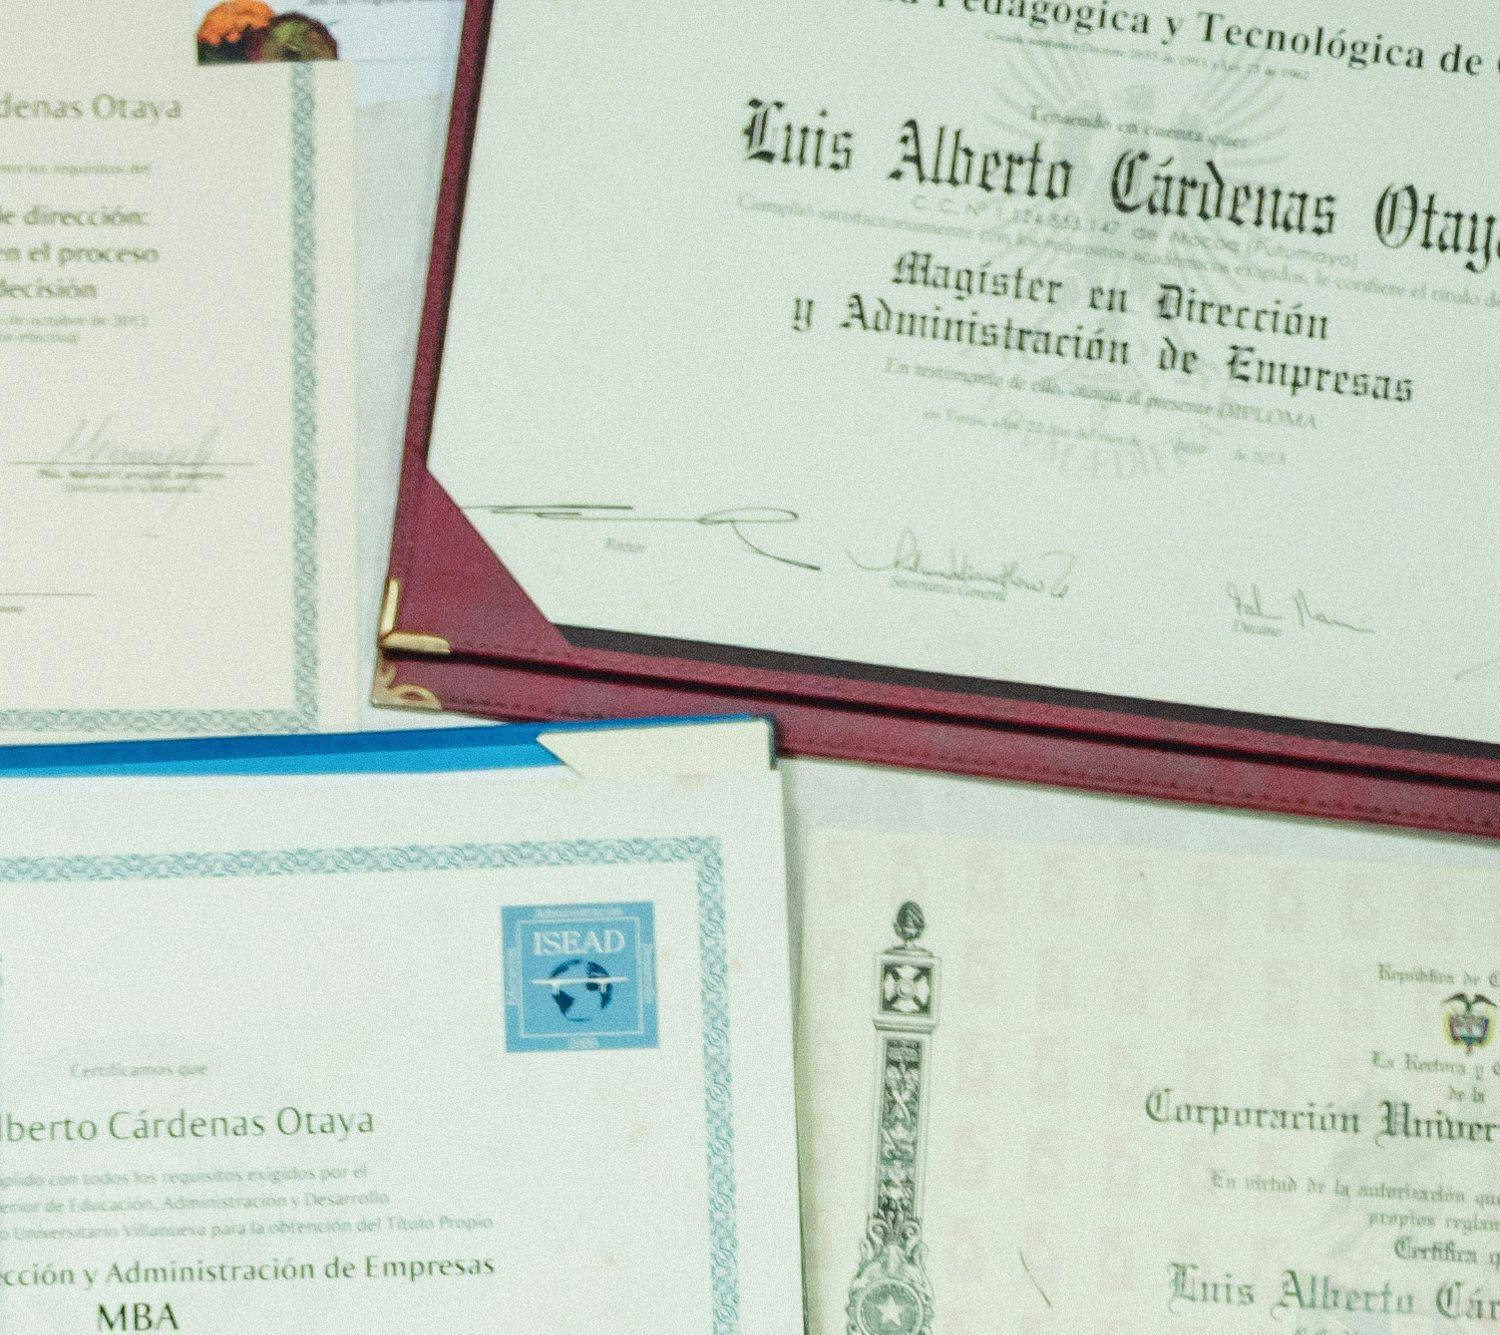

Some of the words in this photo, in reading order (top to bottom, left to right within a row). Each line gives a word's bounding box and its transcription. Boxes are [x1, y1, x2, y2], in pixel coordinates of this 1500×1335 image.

[1164, 15, 1185, 46] y
[1198, 11, 1425, 72] Tecnológica
[1439, 44, 1484, 76] de
[742, 98, 854, 170] Luis
[889, 120, 1074, 202] Alberto
[1111, 144, 1338, 238] Cárdenas
[1088, 283, 1128, 313] en
[1156, 283, 1329, 341] Dirección
[792, 299, 815, 332] y
[839, 294, 1131, 366] Administración
[1157, 338, 1198, 375] de
[1226, 343, 1415, 402] Empresas
[532, 929, 624, 955] ISEAD
[84, 1270, 98, 1289] y
[105, 1256, 313, 1285] Administración
[323, 1256, 356, 1278] de
[364, 1254, 496, 1281] Empresas
[96, 1302, 179, 1333] MBA
